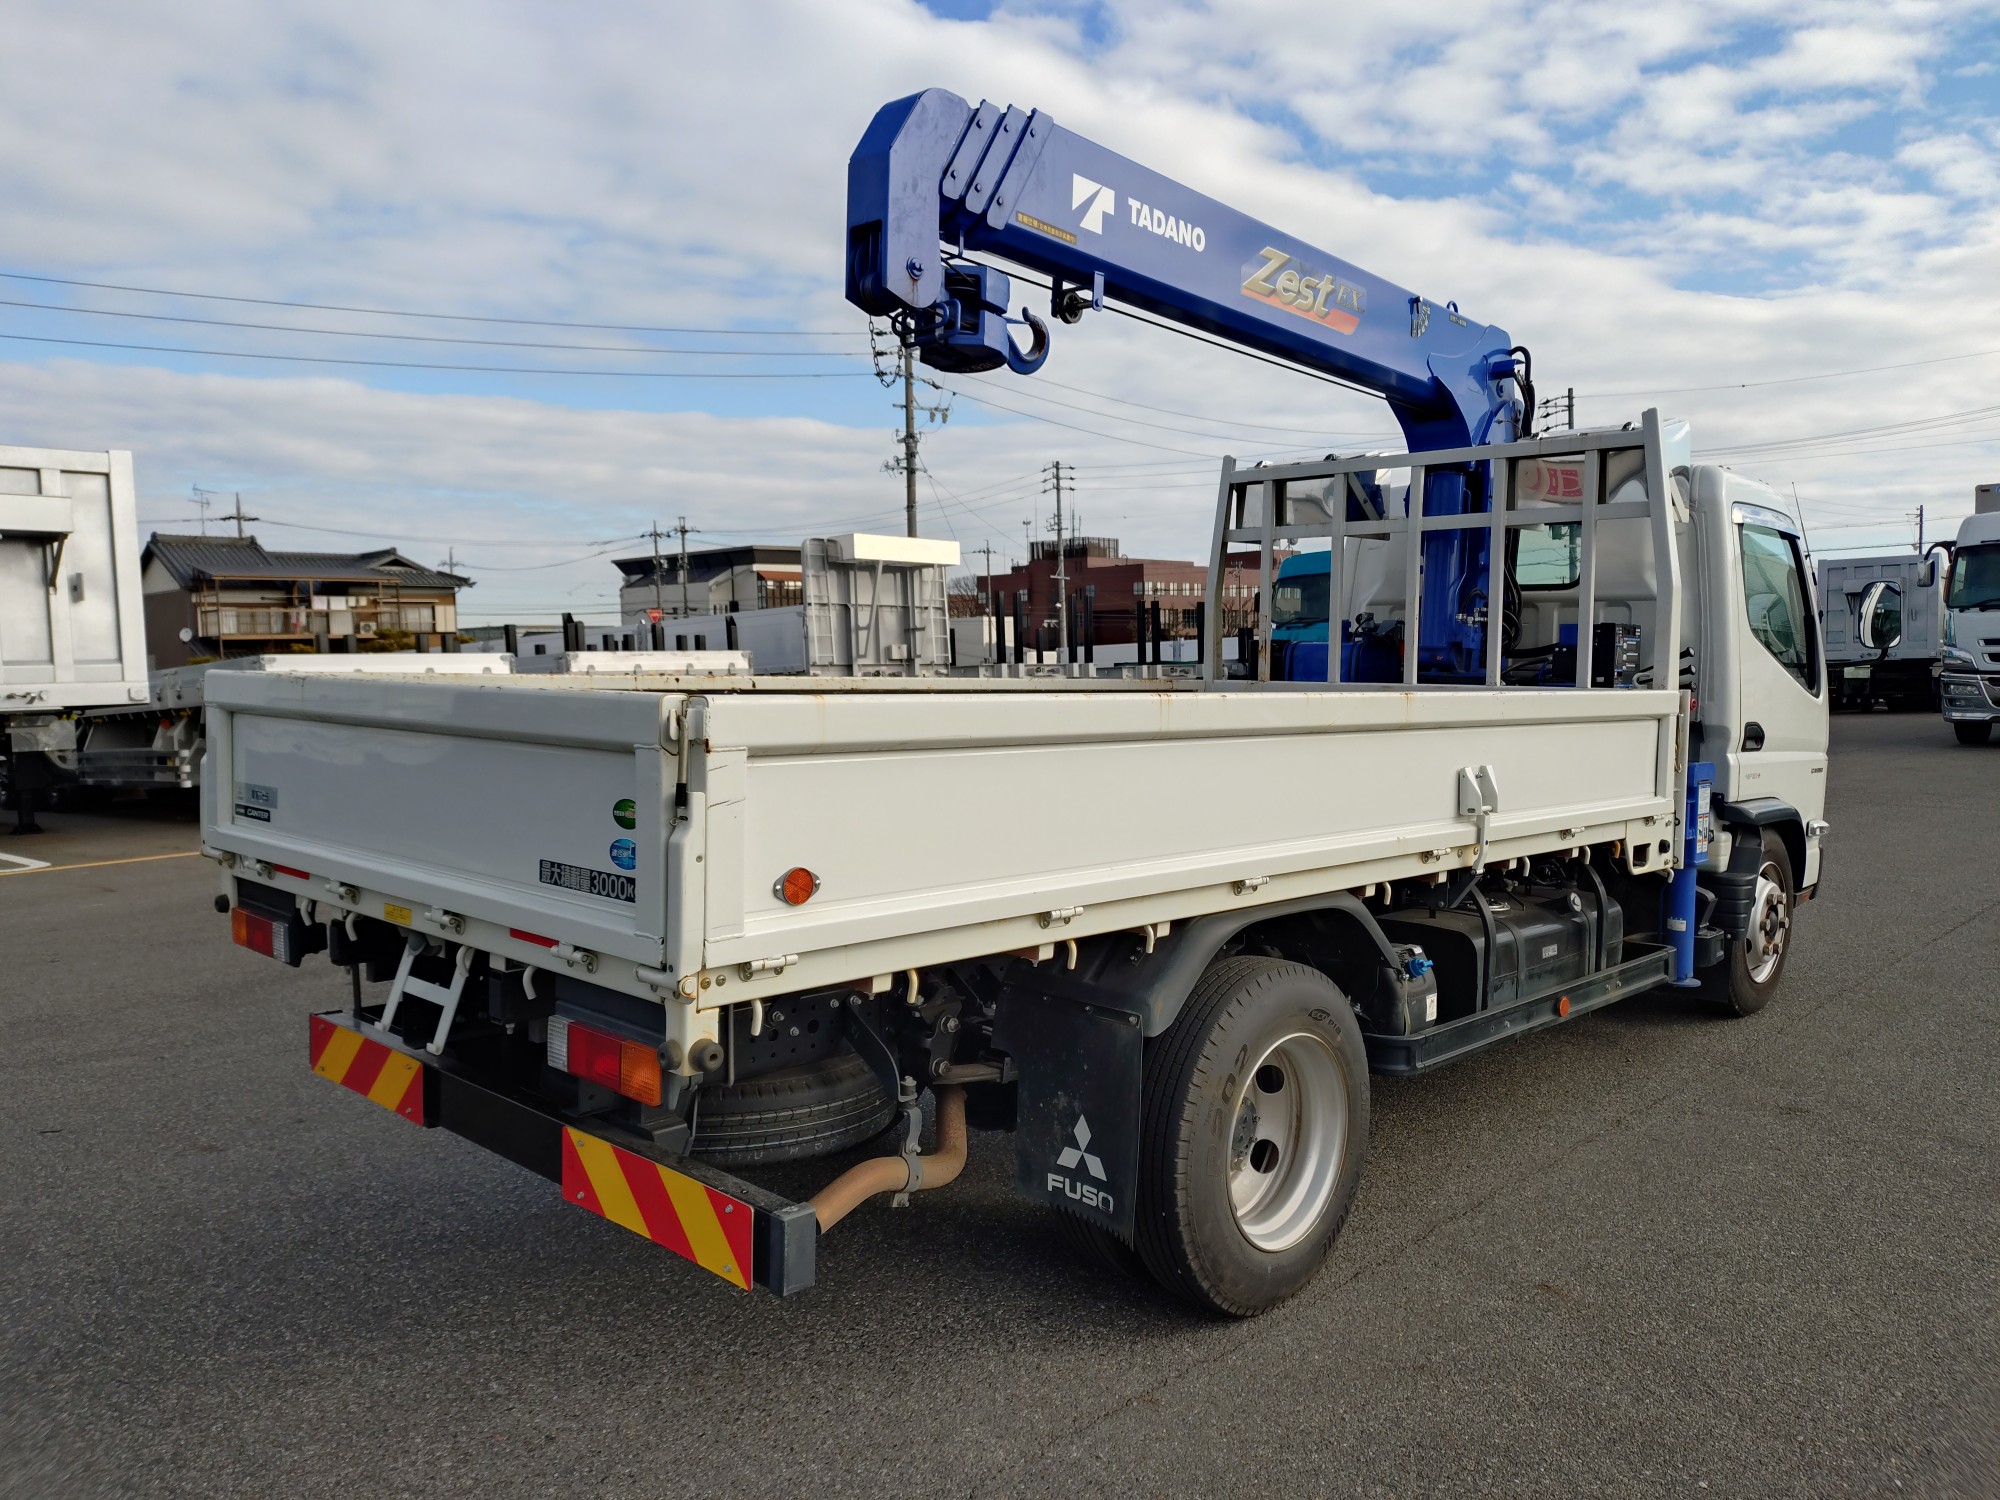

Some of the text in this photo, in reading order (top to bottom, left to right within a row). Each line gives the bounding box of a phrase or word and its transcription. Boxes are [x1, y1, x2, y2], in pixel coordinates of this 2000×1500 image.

[1127, 196, 1206, 252] TADANO
[1242, 246, 1334, 319] Zest
[1047, 1172, 1114, 1214] FUSO
